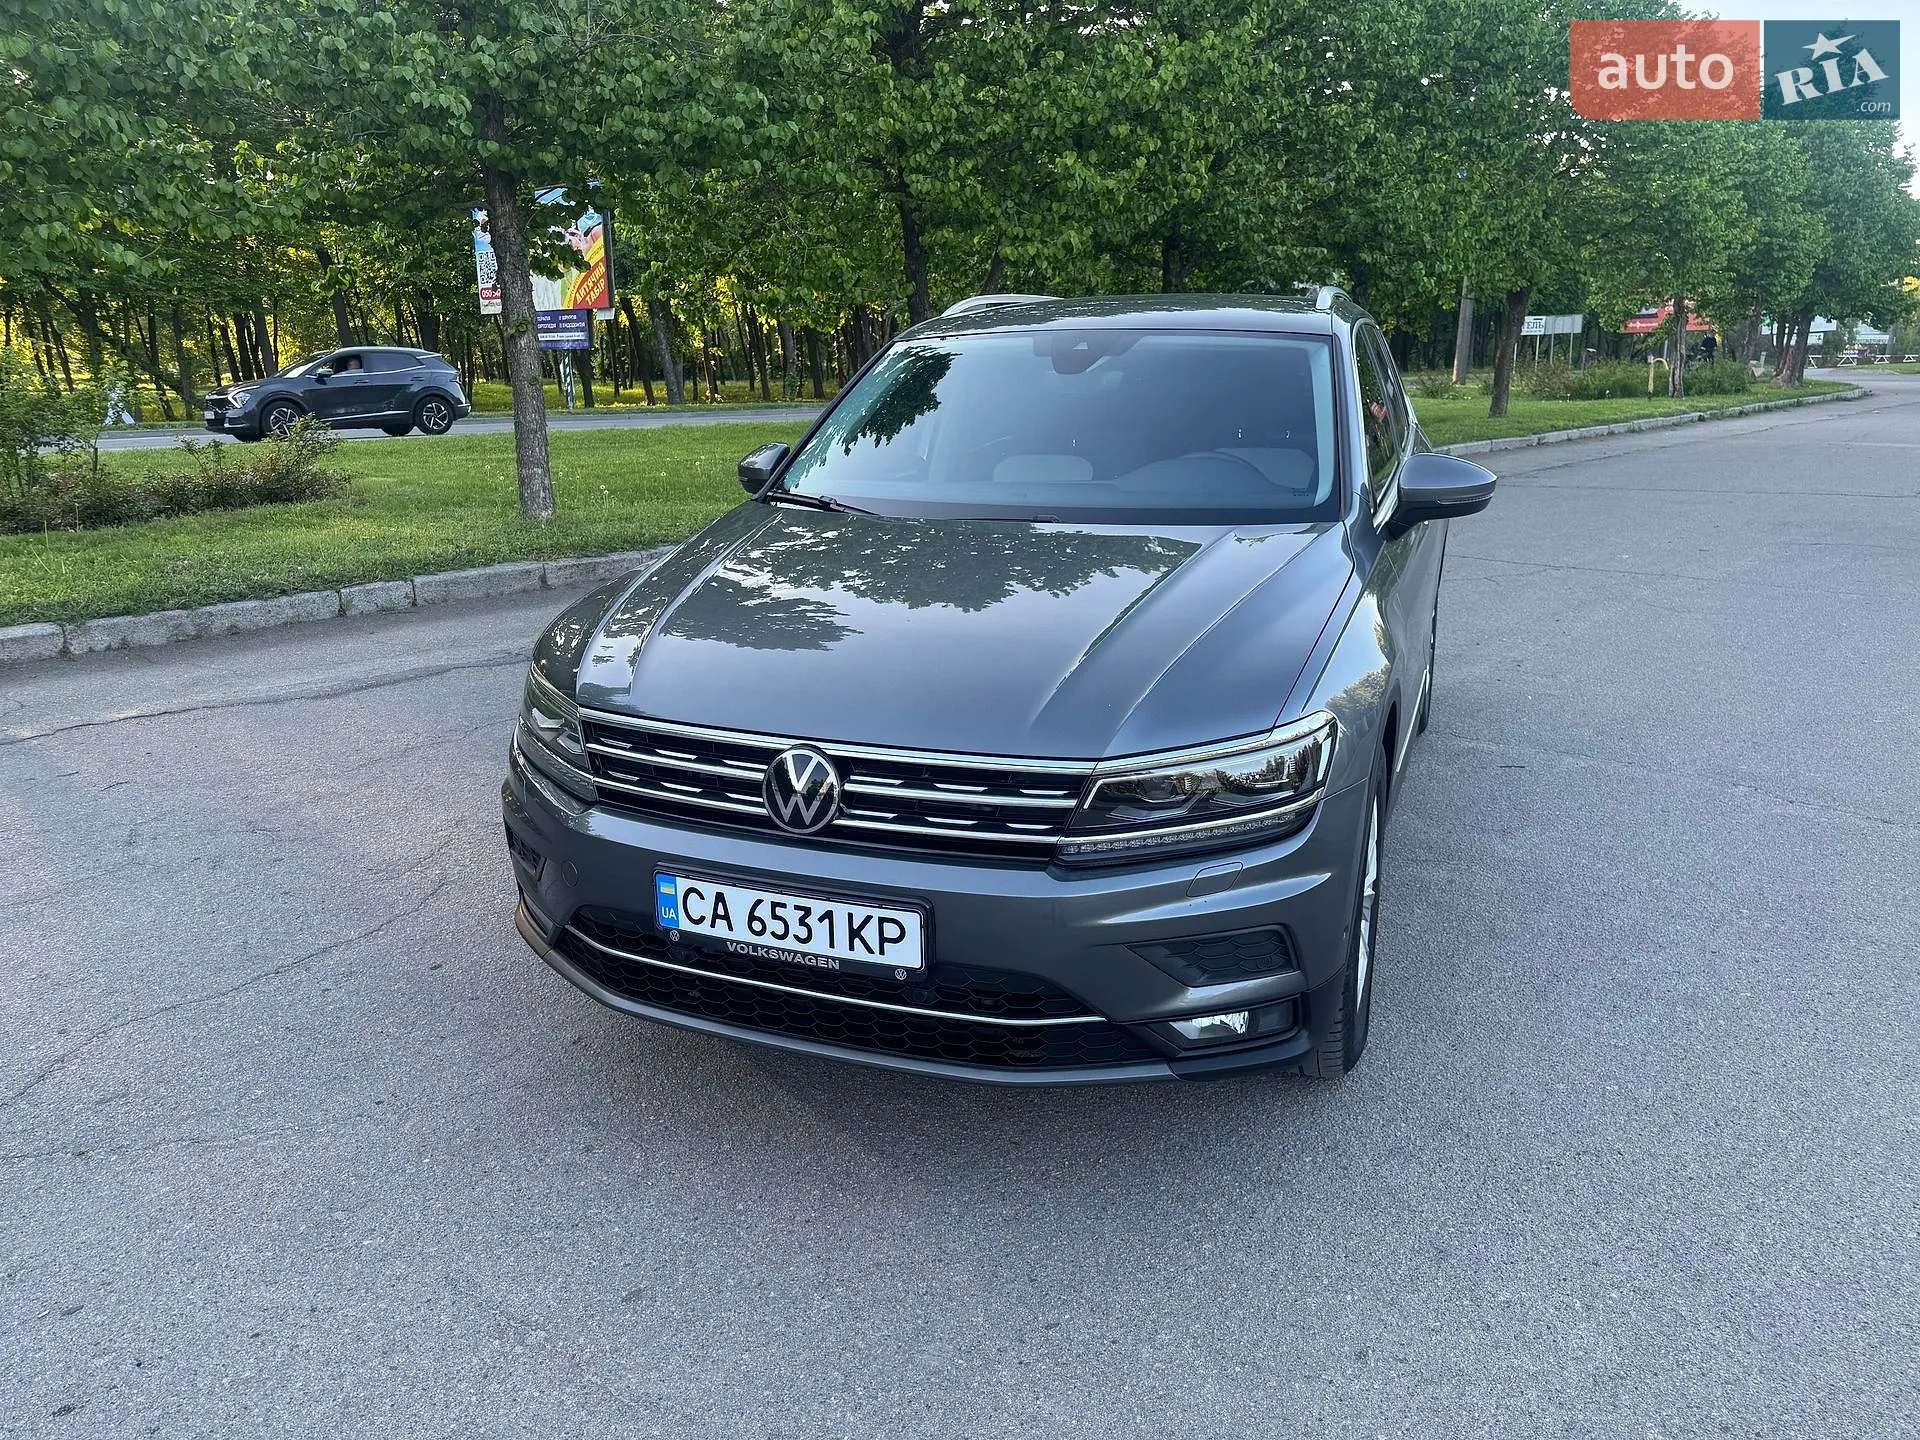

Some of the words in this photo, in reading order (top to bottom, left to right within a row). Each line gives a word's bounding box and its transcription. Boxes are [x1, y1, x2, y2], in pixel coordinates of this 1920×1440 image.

[585, 278, 605, 306] ТАБІР
[661, 905, 678, 921] UA
[681, 886, 734, 932] CA
[726, 941, 840, 970] VOLKSWAGEN
